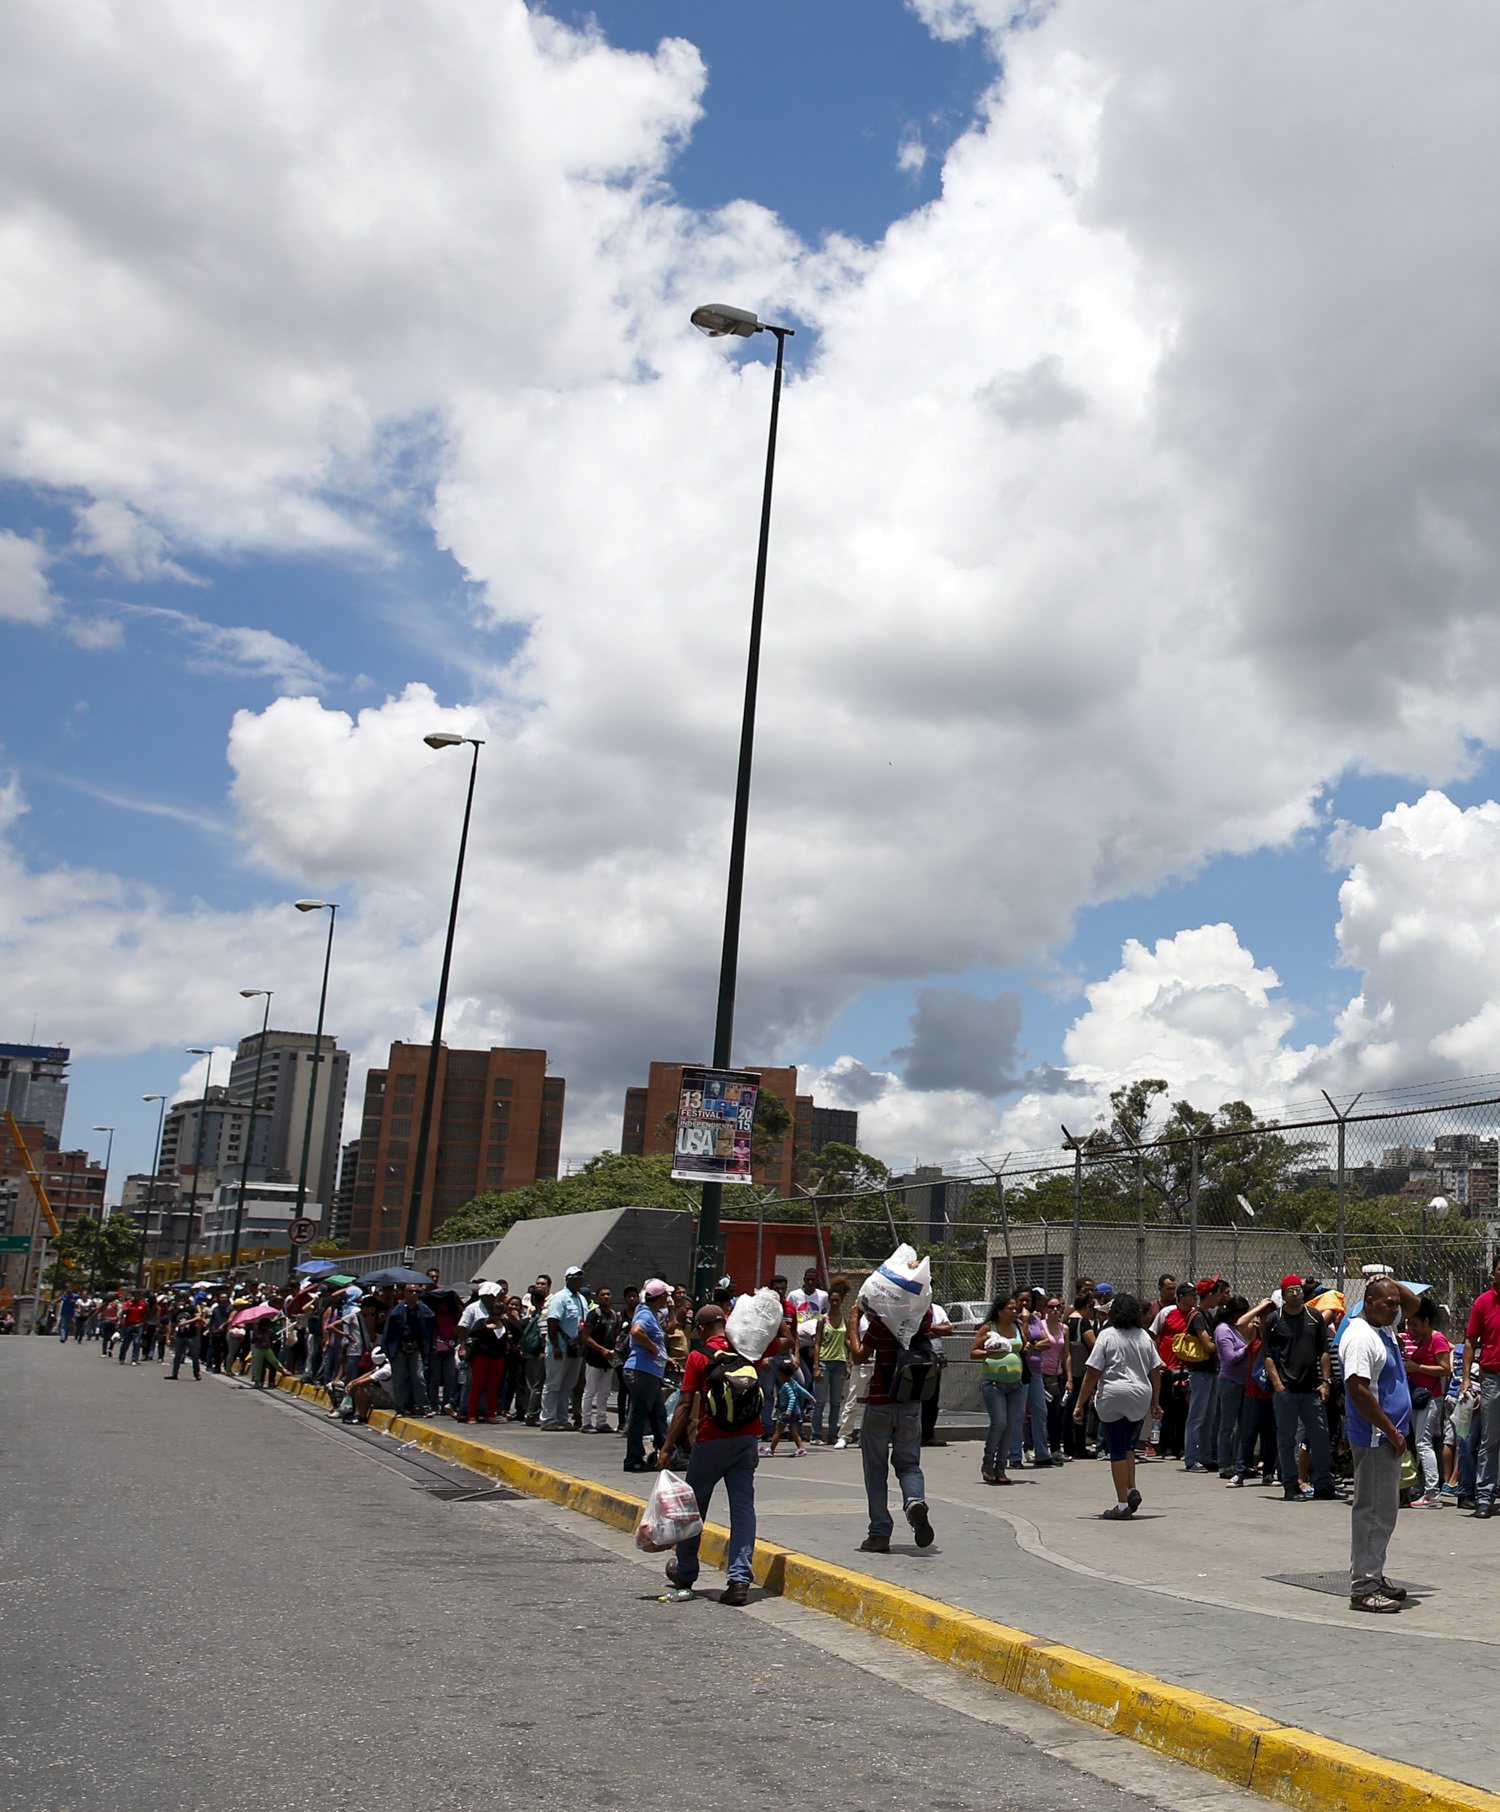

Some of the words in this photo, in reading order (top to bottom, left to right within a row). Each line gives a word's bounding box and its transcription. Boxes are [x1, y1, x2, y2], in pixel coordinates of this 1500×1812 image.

[682, 1091, 702, 1108] 13
[681, 1109, 721, 1118] FESTIVAL
[738, 1108, 752, 1120] 20
[680, 1120, 734, 1130] INDEPENDIENTE
[738, 1120, 751, 1131] 15
[678, 1128, 714, 1155] USA
[298, 1223, 307, 1238] E
